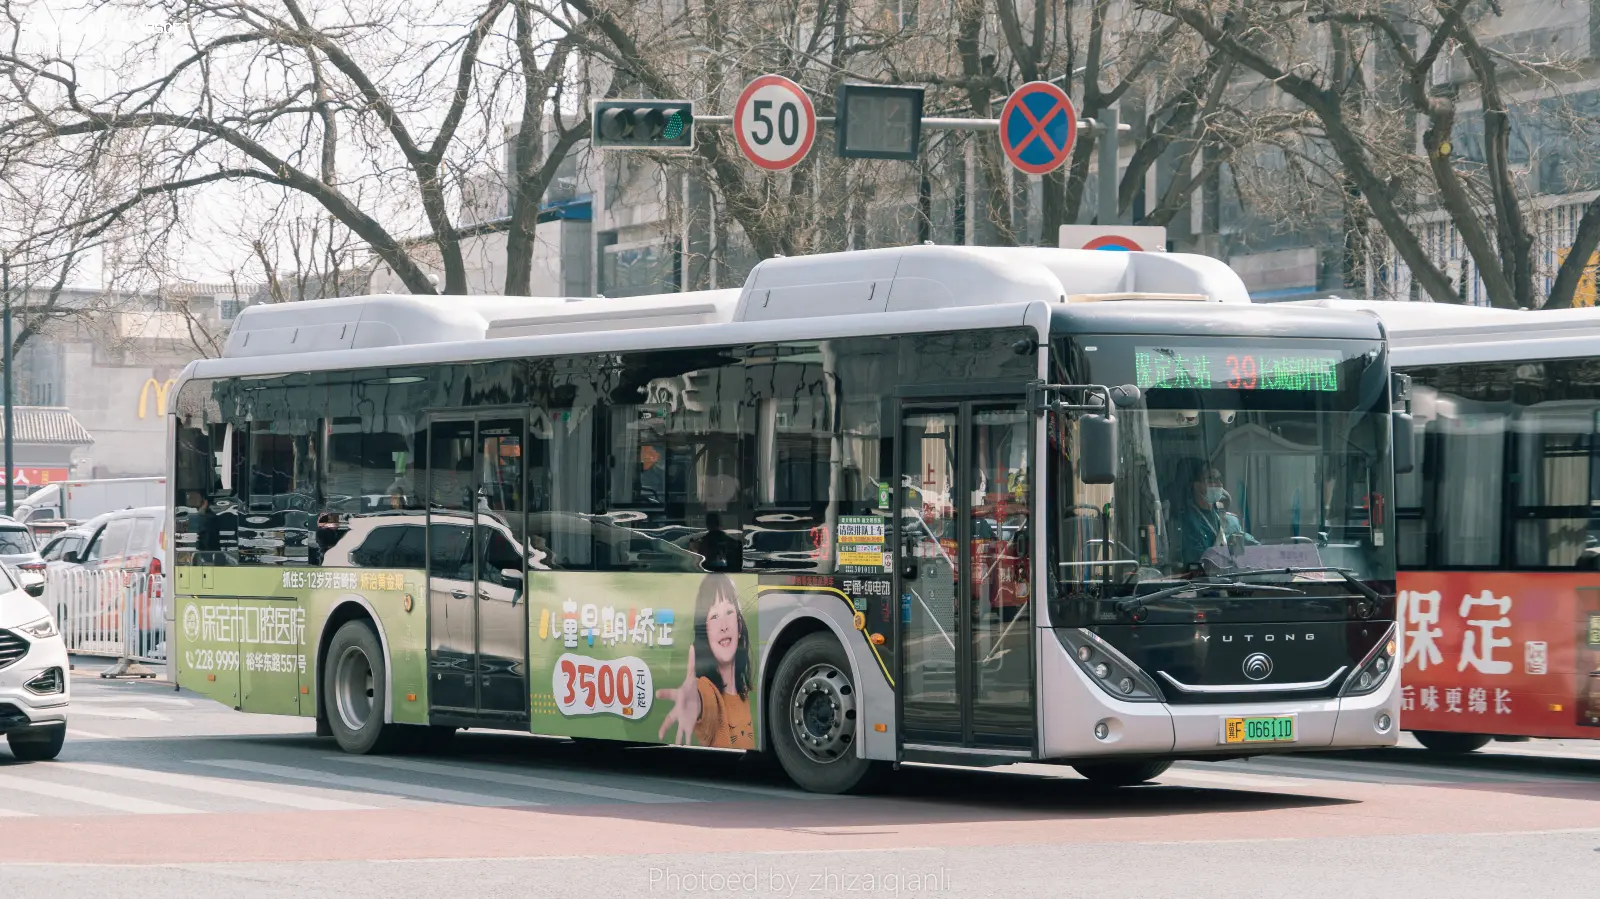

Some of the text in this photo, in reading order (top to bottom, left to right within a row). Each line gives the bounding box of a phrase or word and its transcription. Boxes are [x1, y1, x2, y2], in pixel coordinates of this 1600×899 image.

[751, 100, 799, 146] 50
[1225, 354, 1257, 389] 39
[282, 571, 358, 589] 抓住5-12岁牙齿畸形
[201, 605, 306, 645] 保定市口腔医院
[539, 597, 674, 648] 儿童早期矫正
[1201, 633, 1315, 643] YUTONG
[1397, 589, 1513, 675] 保定
[195, 649, 240, 672] 228 9999
[246, 653, 306, 674] 裕华东路557号
[561, 660, 634, 708] 3500
[1400, 685, 1513, 715] 后味更绵长
